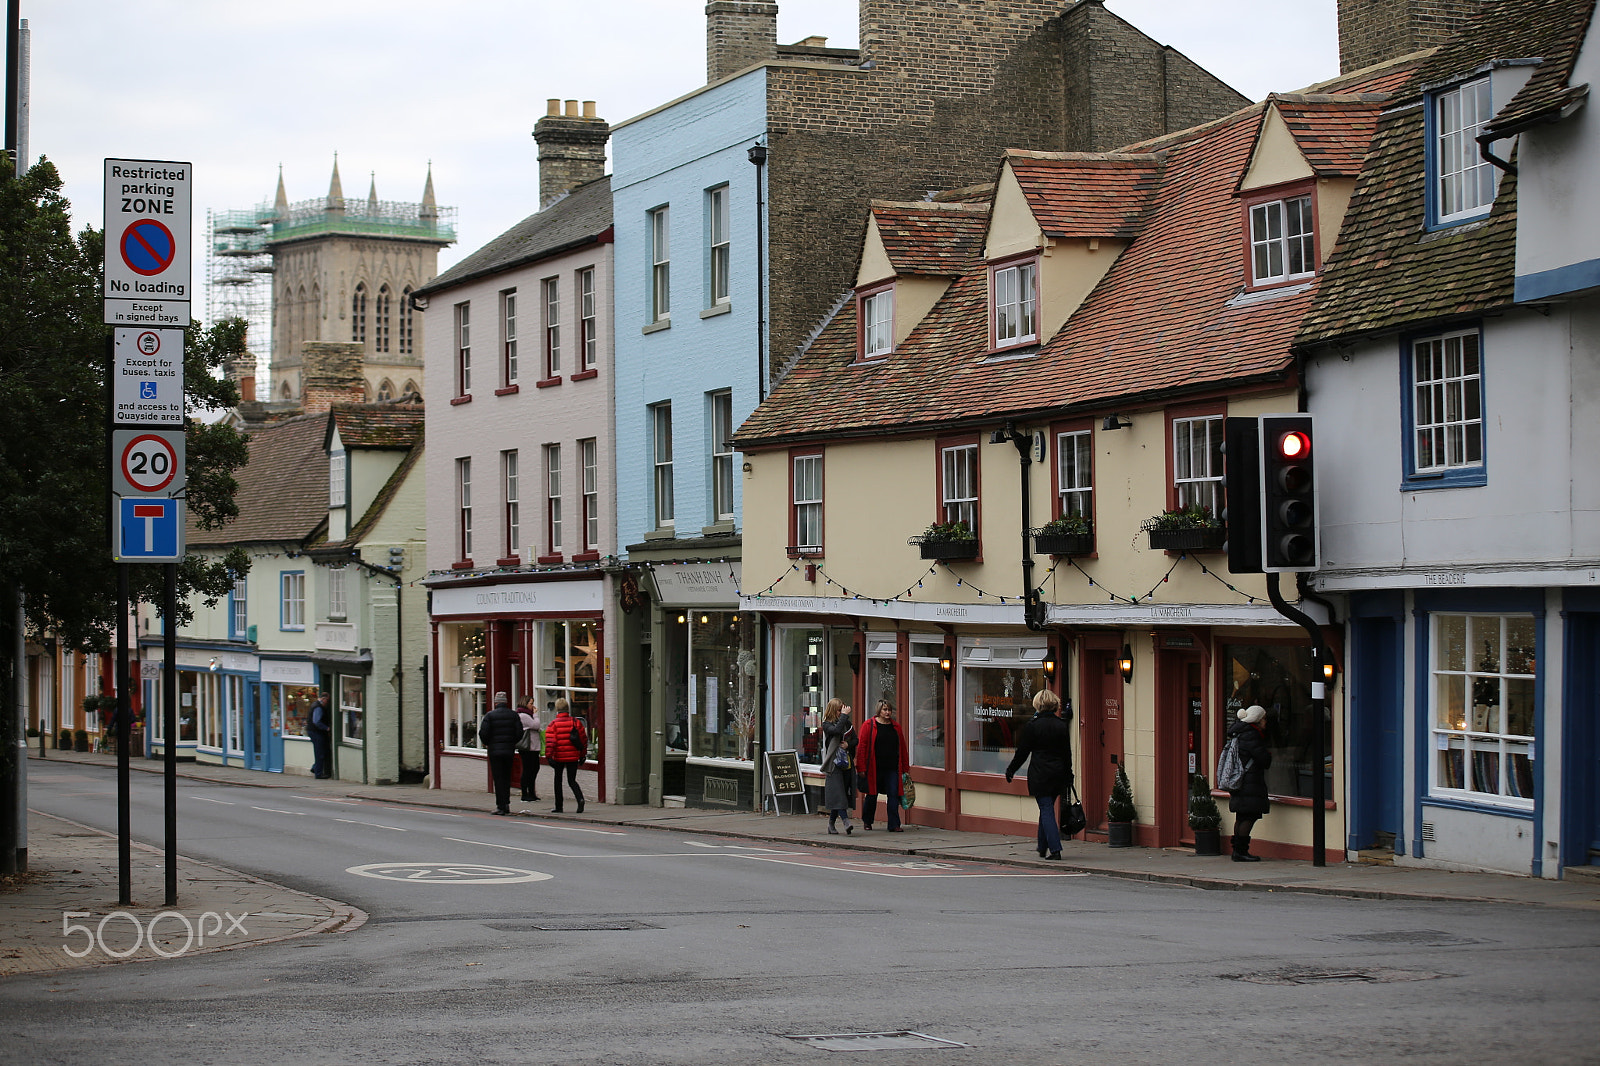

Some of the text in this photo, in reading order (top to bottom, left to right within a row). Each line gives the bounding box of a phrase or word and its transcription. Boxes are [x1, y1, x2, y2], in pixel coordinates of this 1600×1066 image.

[112, 165, 184, 181] Restricted
[121, 183, 174, 197] parking
[121, 198, 174, 214] ZONE
[110, 280, 184, 296] No loading
[132, 303, 163, 312] Except
[115, 312, 179, 323] in signed bays
[126, 358, 172, 368] Except for
[154, 369, 176, 377] taxis
[118, 402, 179, 411] and access to
[117, 412, 158, 421] Quayside
[131, 451, 168, 475] 20
[675, 571, 704, 585] THANH
[702, 570, 724, 584] BINH
[1424, 572, 1466, 585] THE BEADERIE
[780, 781, 796, 789] £15
